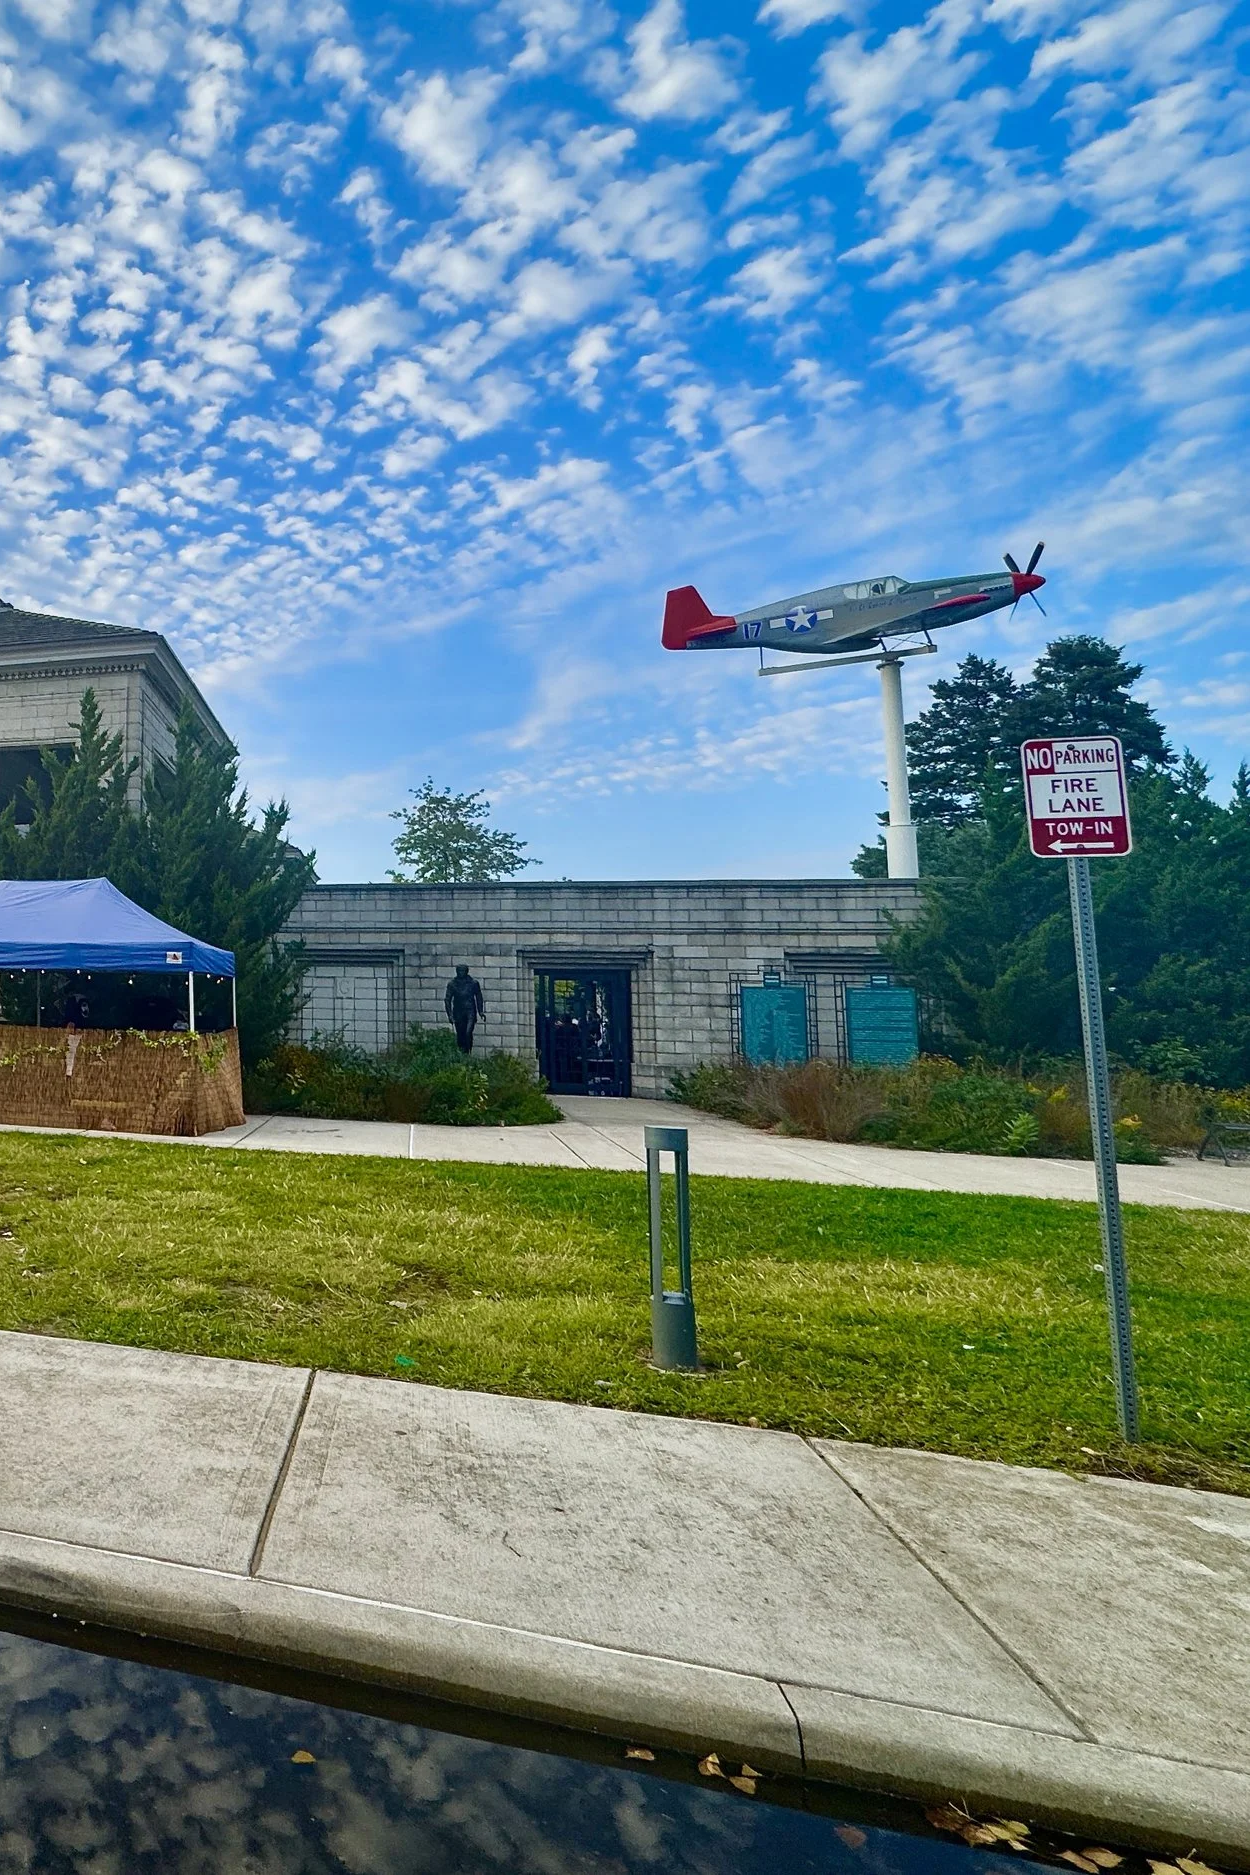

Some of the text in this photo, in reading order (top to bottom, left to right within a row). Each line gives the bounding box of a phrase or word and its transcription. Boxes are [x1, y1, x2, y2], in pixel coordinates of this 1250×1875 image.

[742, 621, 762, 640] 17
[1026, 748, 1115, 770] NO PARKING
[1051, 778, 1098, 793] FIRE
[1049, 797, 1105, 813] LANE
[1045, 821, 1113, 836] TOW-IN
